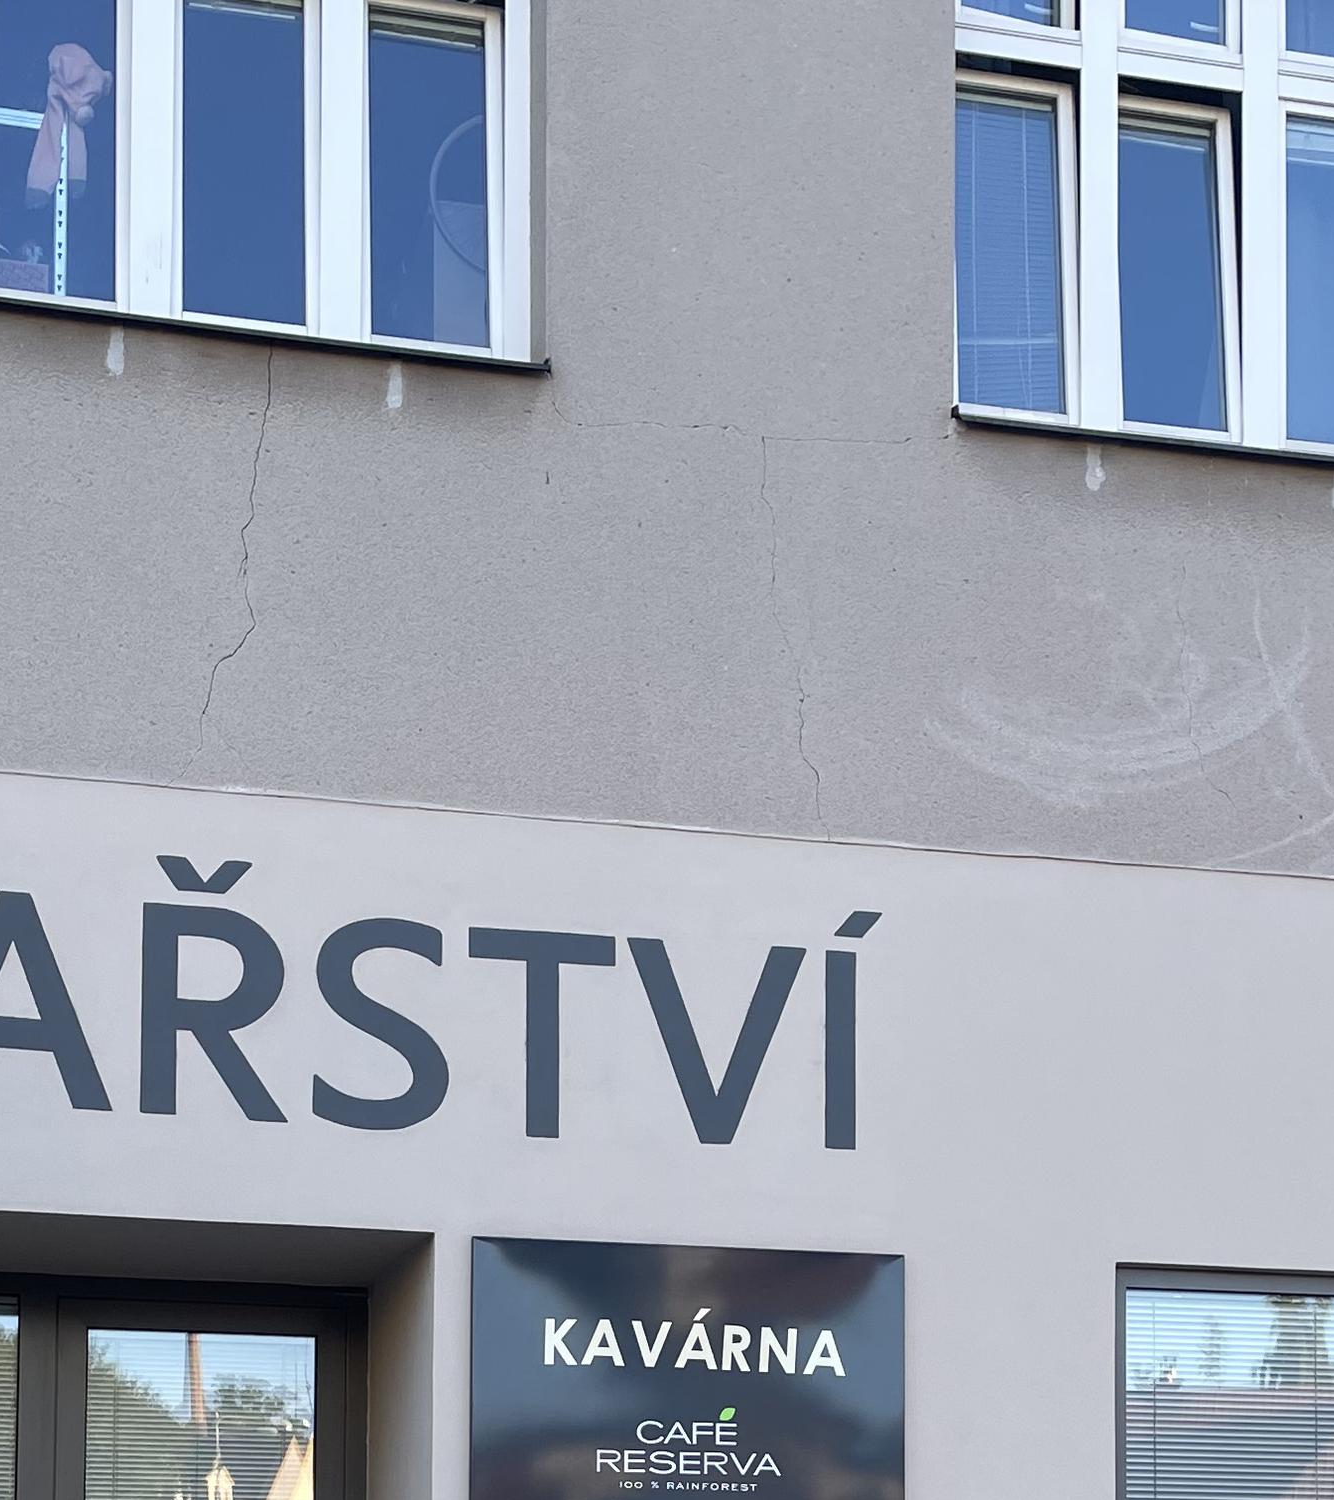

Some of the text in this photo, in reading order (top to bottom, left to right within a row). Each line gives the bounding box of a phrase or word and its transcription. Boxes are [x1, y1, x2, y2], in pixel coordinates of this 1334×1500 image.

[543, 1307, 847, 1377] KAVÁRNA
[635, 1407, 738, 1446] CAFÉ
[595, 1449, 782, 1477] RESERVA
[619, 1480, 644, 1489] 100
[666, 1481, 758, 1492] RAINFOREST
